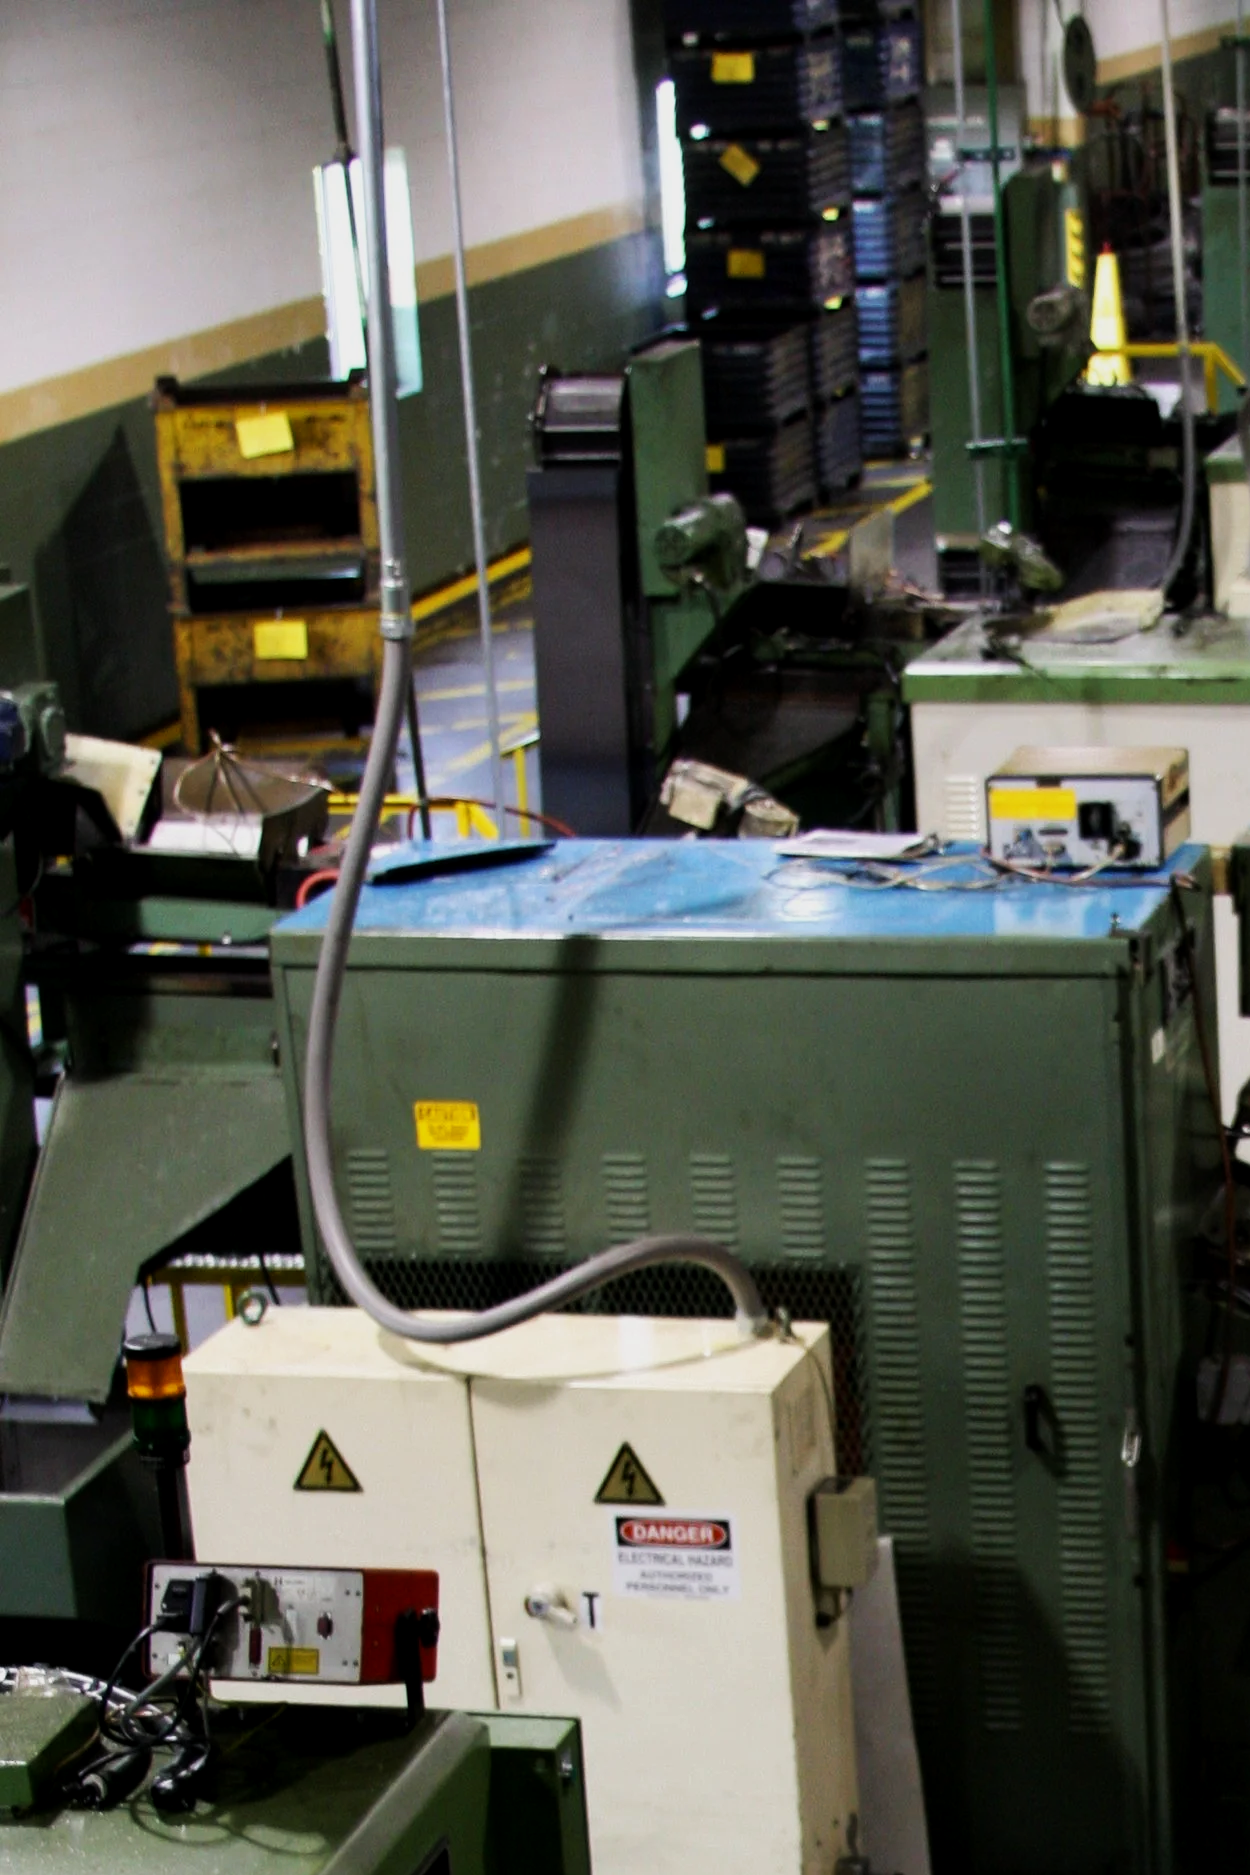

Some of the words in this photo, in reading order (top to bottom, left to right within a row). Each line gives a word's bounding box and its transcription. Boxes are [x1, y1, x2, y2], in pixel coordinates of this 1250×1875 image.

[633, 1524, 713, 1543] DANGER
[618, 1552, 685, 1566] ELECTRICAL
[688, 1554, 733, 1567] HAZARD
